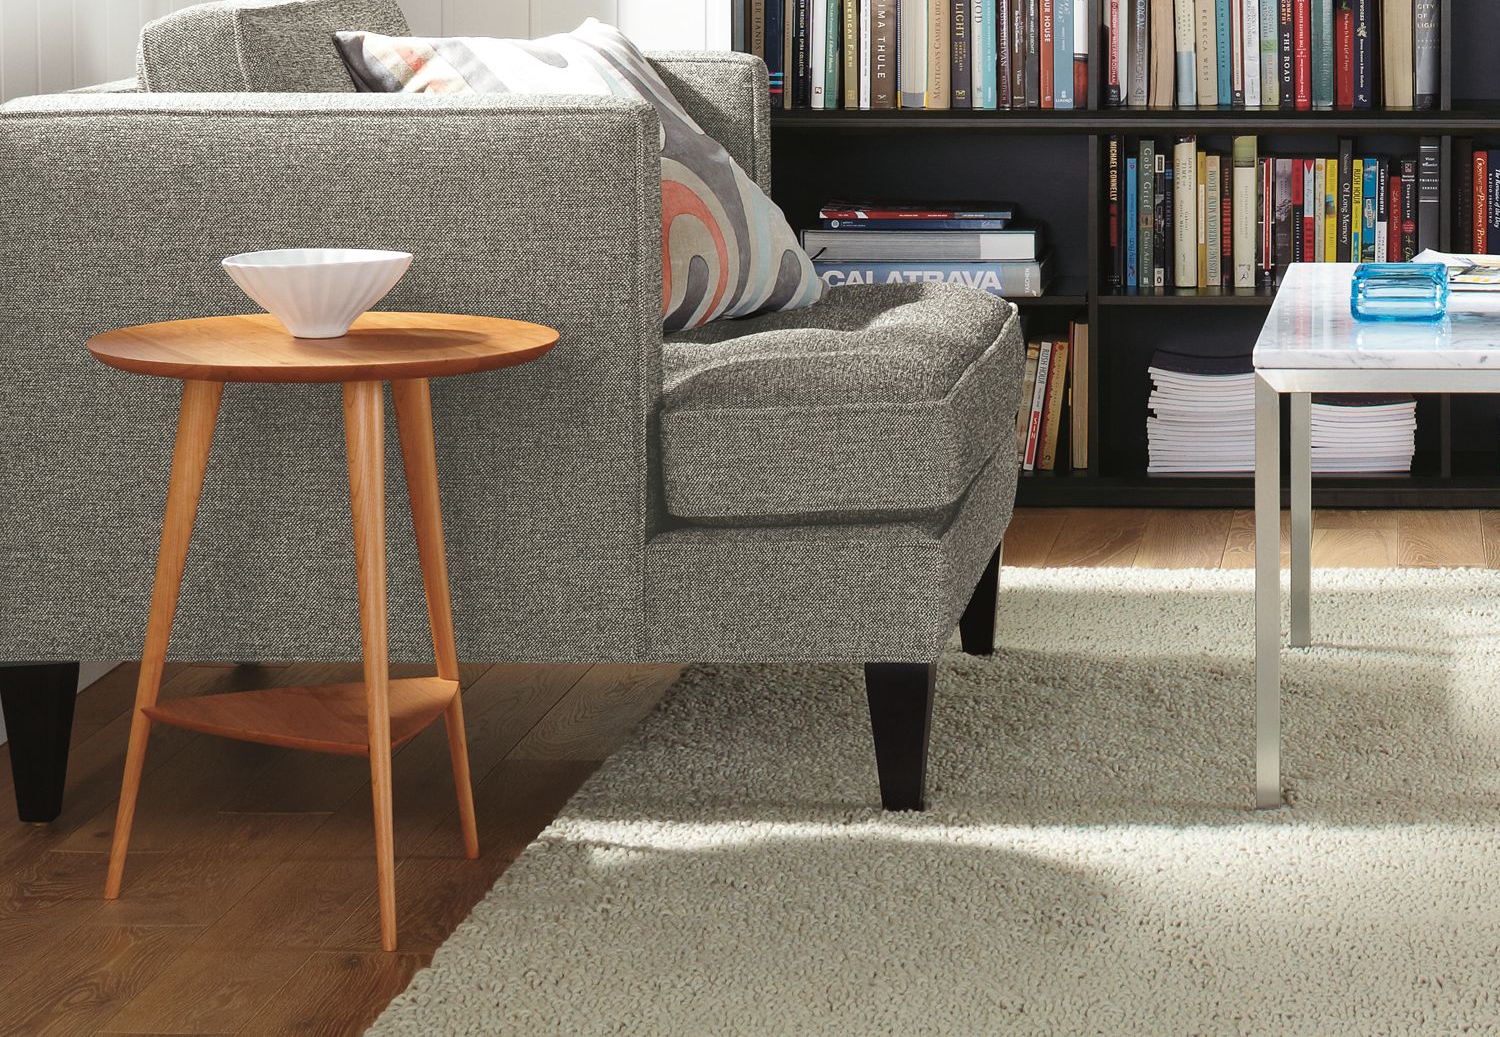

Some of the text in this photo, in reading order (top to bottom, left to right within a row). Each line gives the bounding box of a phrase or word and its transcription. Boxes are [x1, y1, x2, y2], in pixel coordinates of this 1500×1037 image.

[956, 3, 964, 38] LIGHT
[877, 37, 885, 79] THULE
[1143, 147, 1152, 209] Gob's Grief
[1340, 183, 1350, 244] Of Long Memory
[1038, 349, 1050, 384] RUSH HOUR
